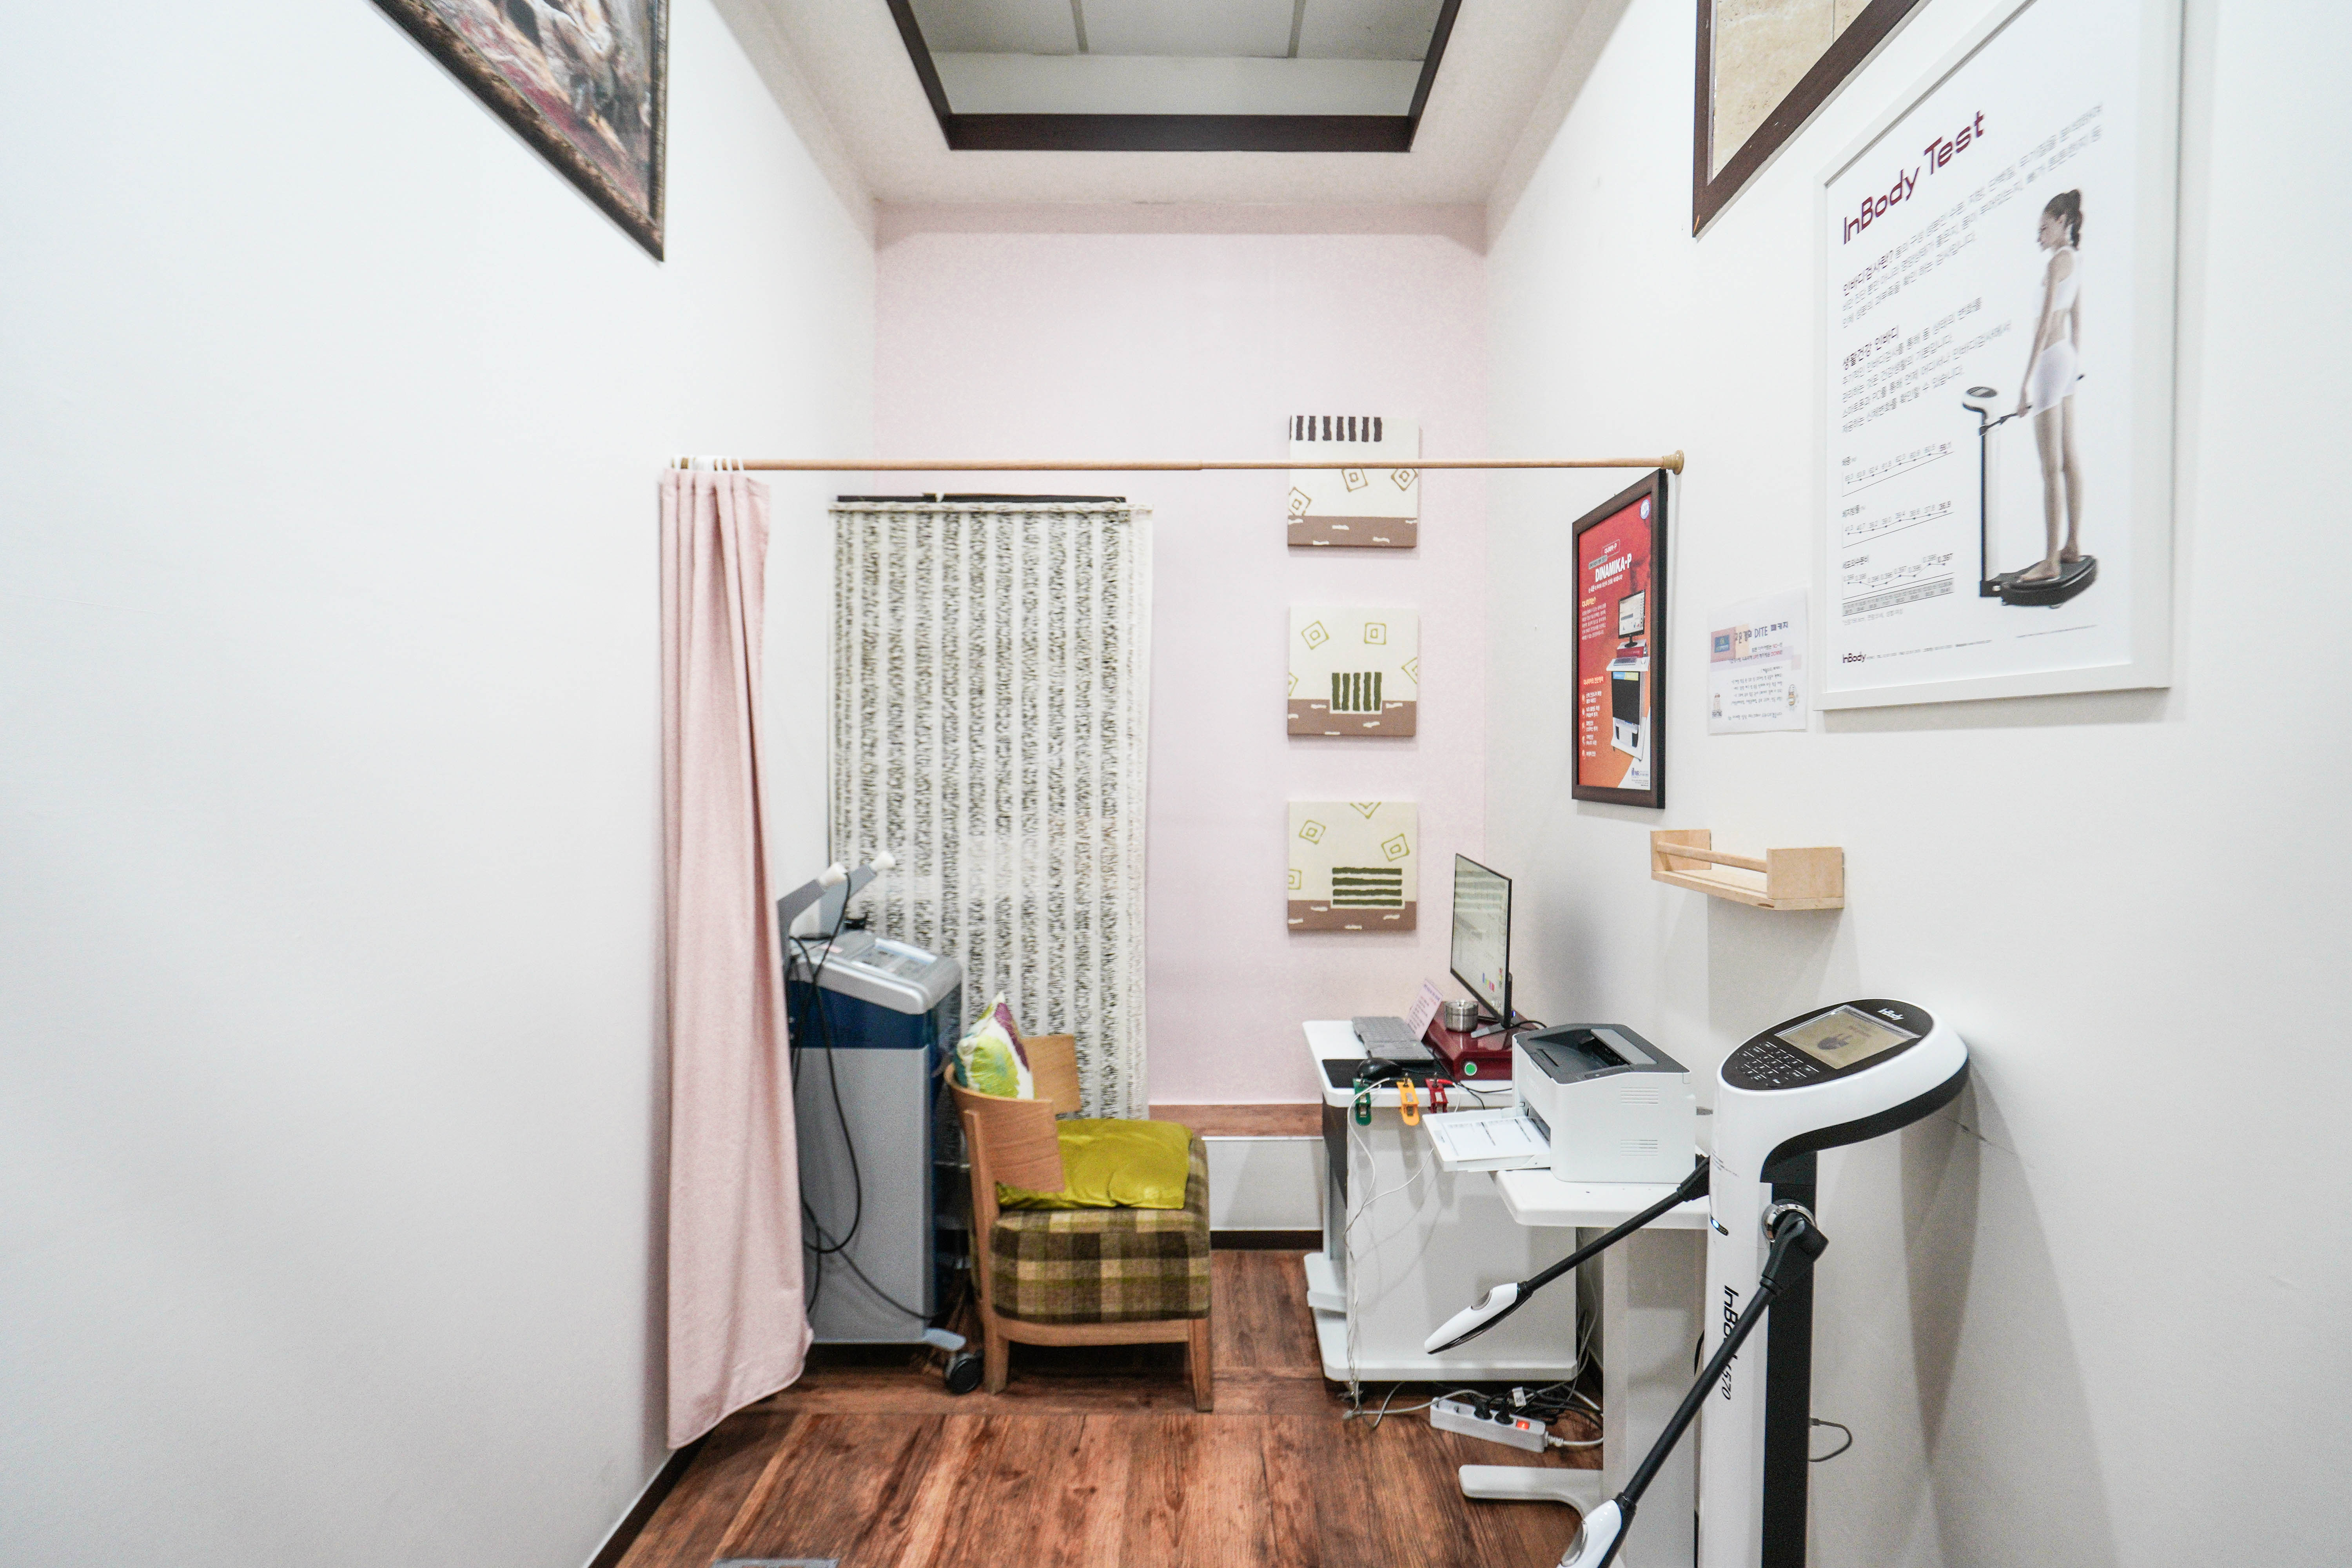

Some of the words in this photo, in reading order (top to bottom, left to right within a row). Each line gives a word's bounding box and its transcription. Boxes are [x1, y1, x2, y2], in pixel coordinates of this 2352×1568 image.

[1844, 165, 1920, 245] InBody
[1923, 110, 1985, 175] Test
[1842, 344, 1872, 370] 생활건강
[1875, 327, 1898, 351] 인바디
[1595, 553, 1632, 583] DINAMIKA-P
[1842, 653, 1866, 664] InBody
[1877, 1008, 1904, 1020] InBody
